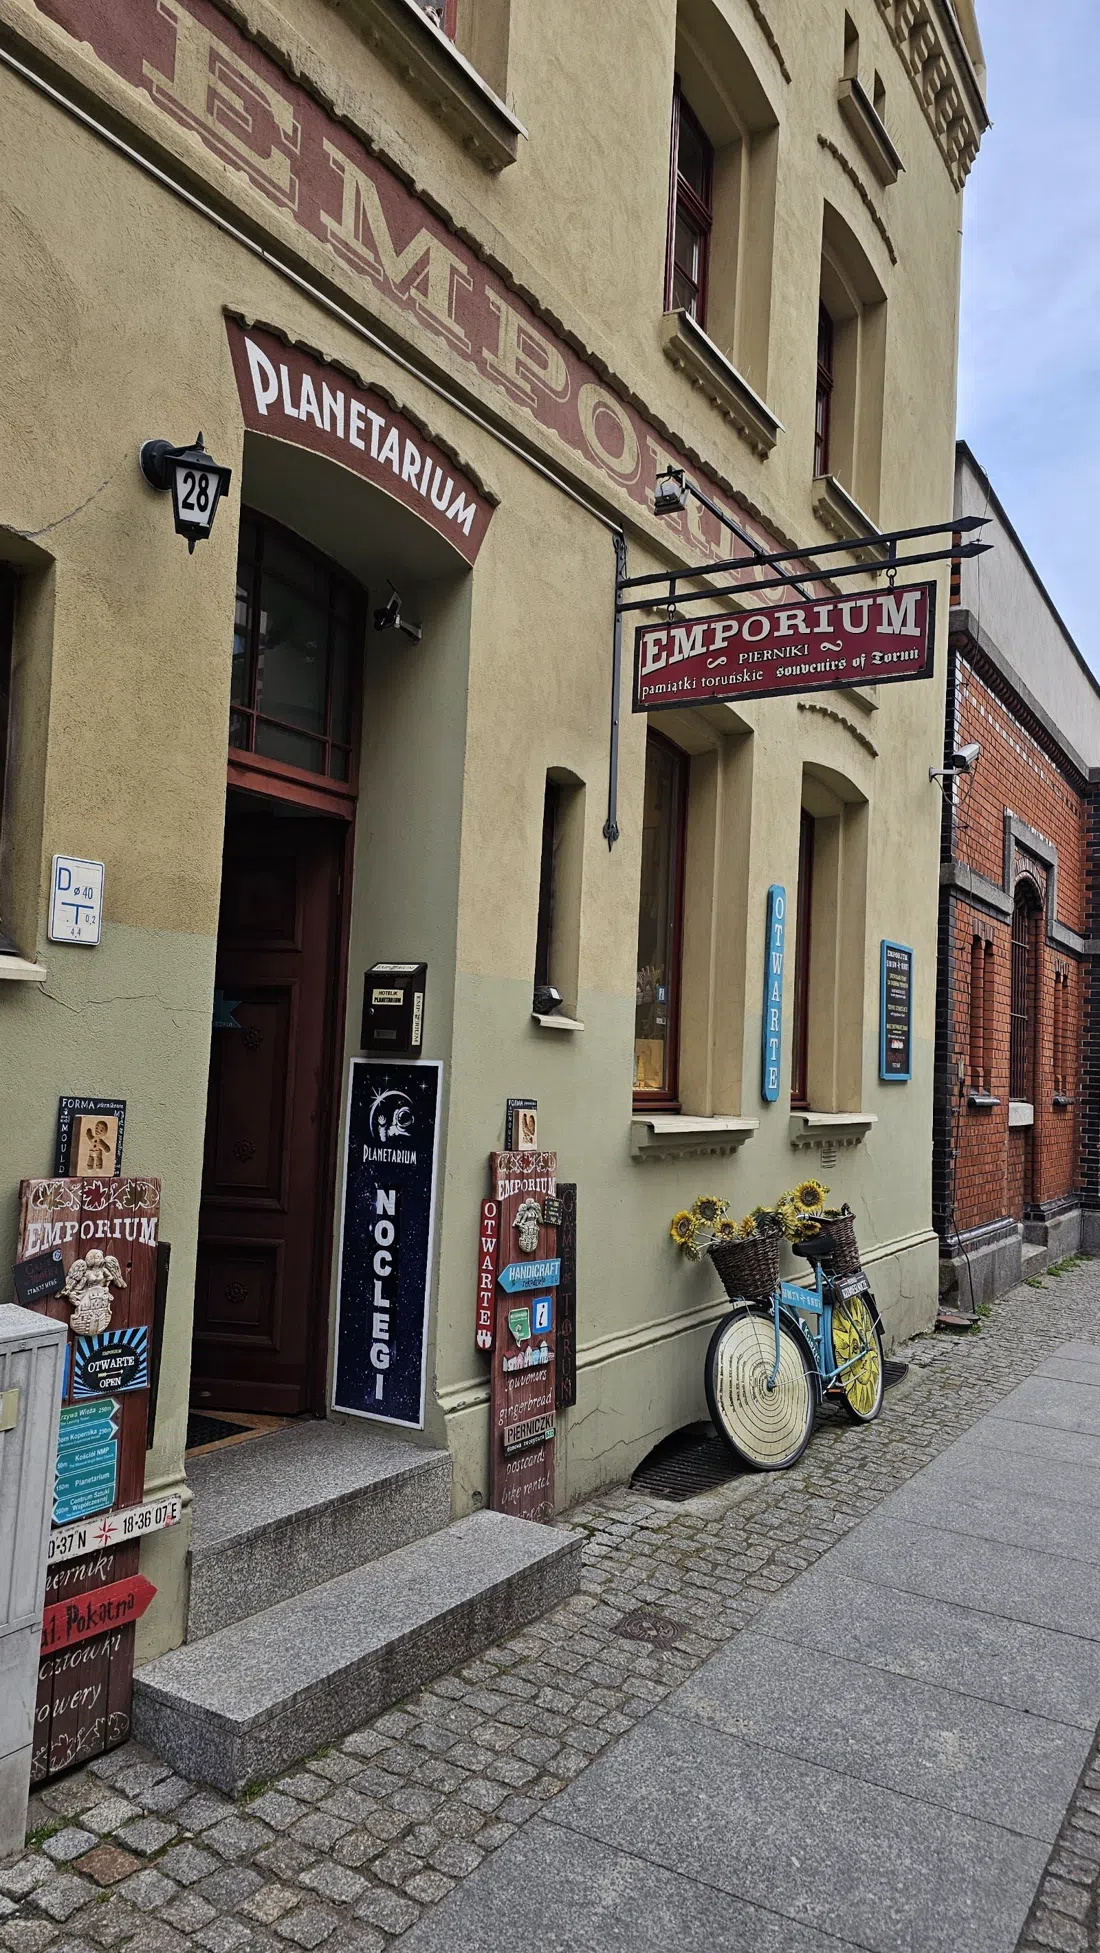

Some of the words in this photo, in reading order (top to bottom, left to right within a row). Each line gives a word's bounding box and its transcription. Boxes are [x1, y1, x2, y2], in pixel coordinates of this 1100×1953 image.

[142, 0, 816, 605] EMPORIU
[244, 336, 478, 536] PLANETARIUM
[182, 471, 210, 513] 28
[641, 591, 922, 676] EMPORIUM
[738, 644, 810, 664] PIERNIKI
[642, 678, 698, 700] pamiątki
[701, 669, 764, 687] toruńskie
[776, 658, 848, 678] souvenirs
[852, 653, 867, 669] of
[871, 646, 919, 665] Toruń
[58, 866, 71, 891] D
[82, 886, 94, 900] 40
[768, 896, 784, 1089] OTWARTE
[62, 1098, 95, 1110] FORMA
[58, 1124, 69, 1173] MOULD
[362, 1145, 417, 1166] PLANETARIUM
[497, 1177, 556, 1201] EMPORIUM
[25, 1217, 158, 1258] EMPORIUM
[480, 1202, 497, 1325] OTWARTE
[510, 1262, 560, 1281] HANDICRAFT
[370, 1189, 396, 1401] NOCLEGI
[88, 1356, 134, 1372] OTWARTE
[100, 1377, 121, 1388] OPEN
[61, 1411, 78, 1421] rzywa
[80, 1407, 97, 1416] Wieża
[499, 1387, 552, 1426] gingerbread
[507, 1414, 554, 1443] PIERNICZKI
[96, 1447, 109, 1455] NMP
[505, 1446, 545, 1481] postcards
[56, 1483, 69, 1491] 150m
[75, 1472, 110, 1487] Planetarium
[501, 1483, 521, 1505] bike
[70, 1494, 93, 1506] Centrum
[45, 1550, 114, 1591] ierniki
[37, 1683, 102, 1723] owery
